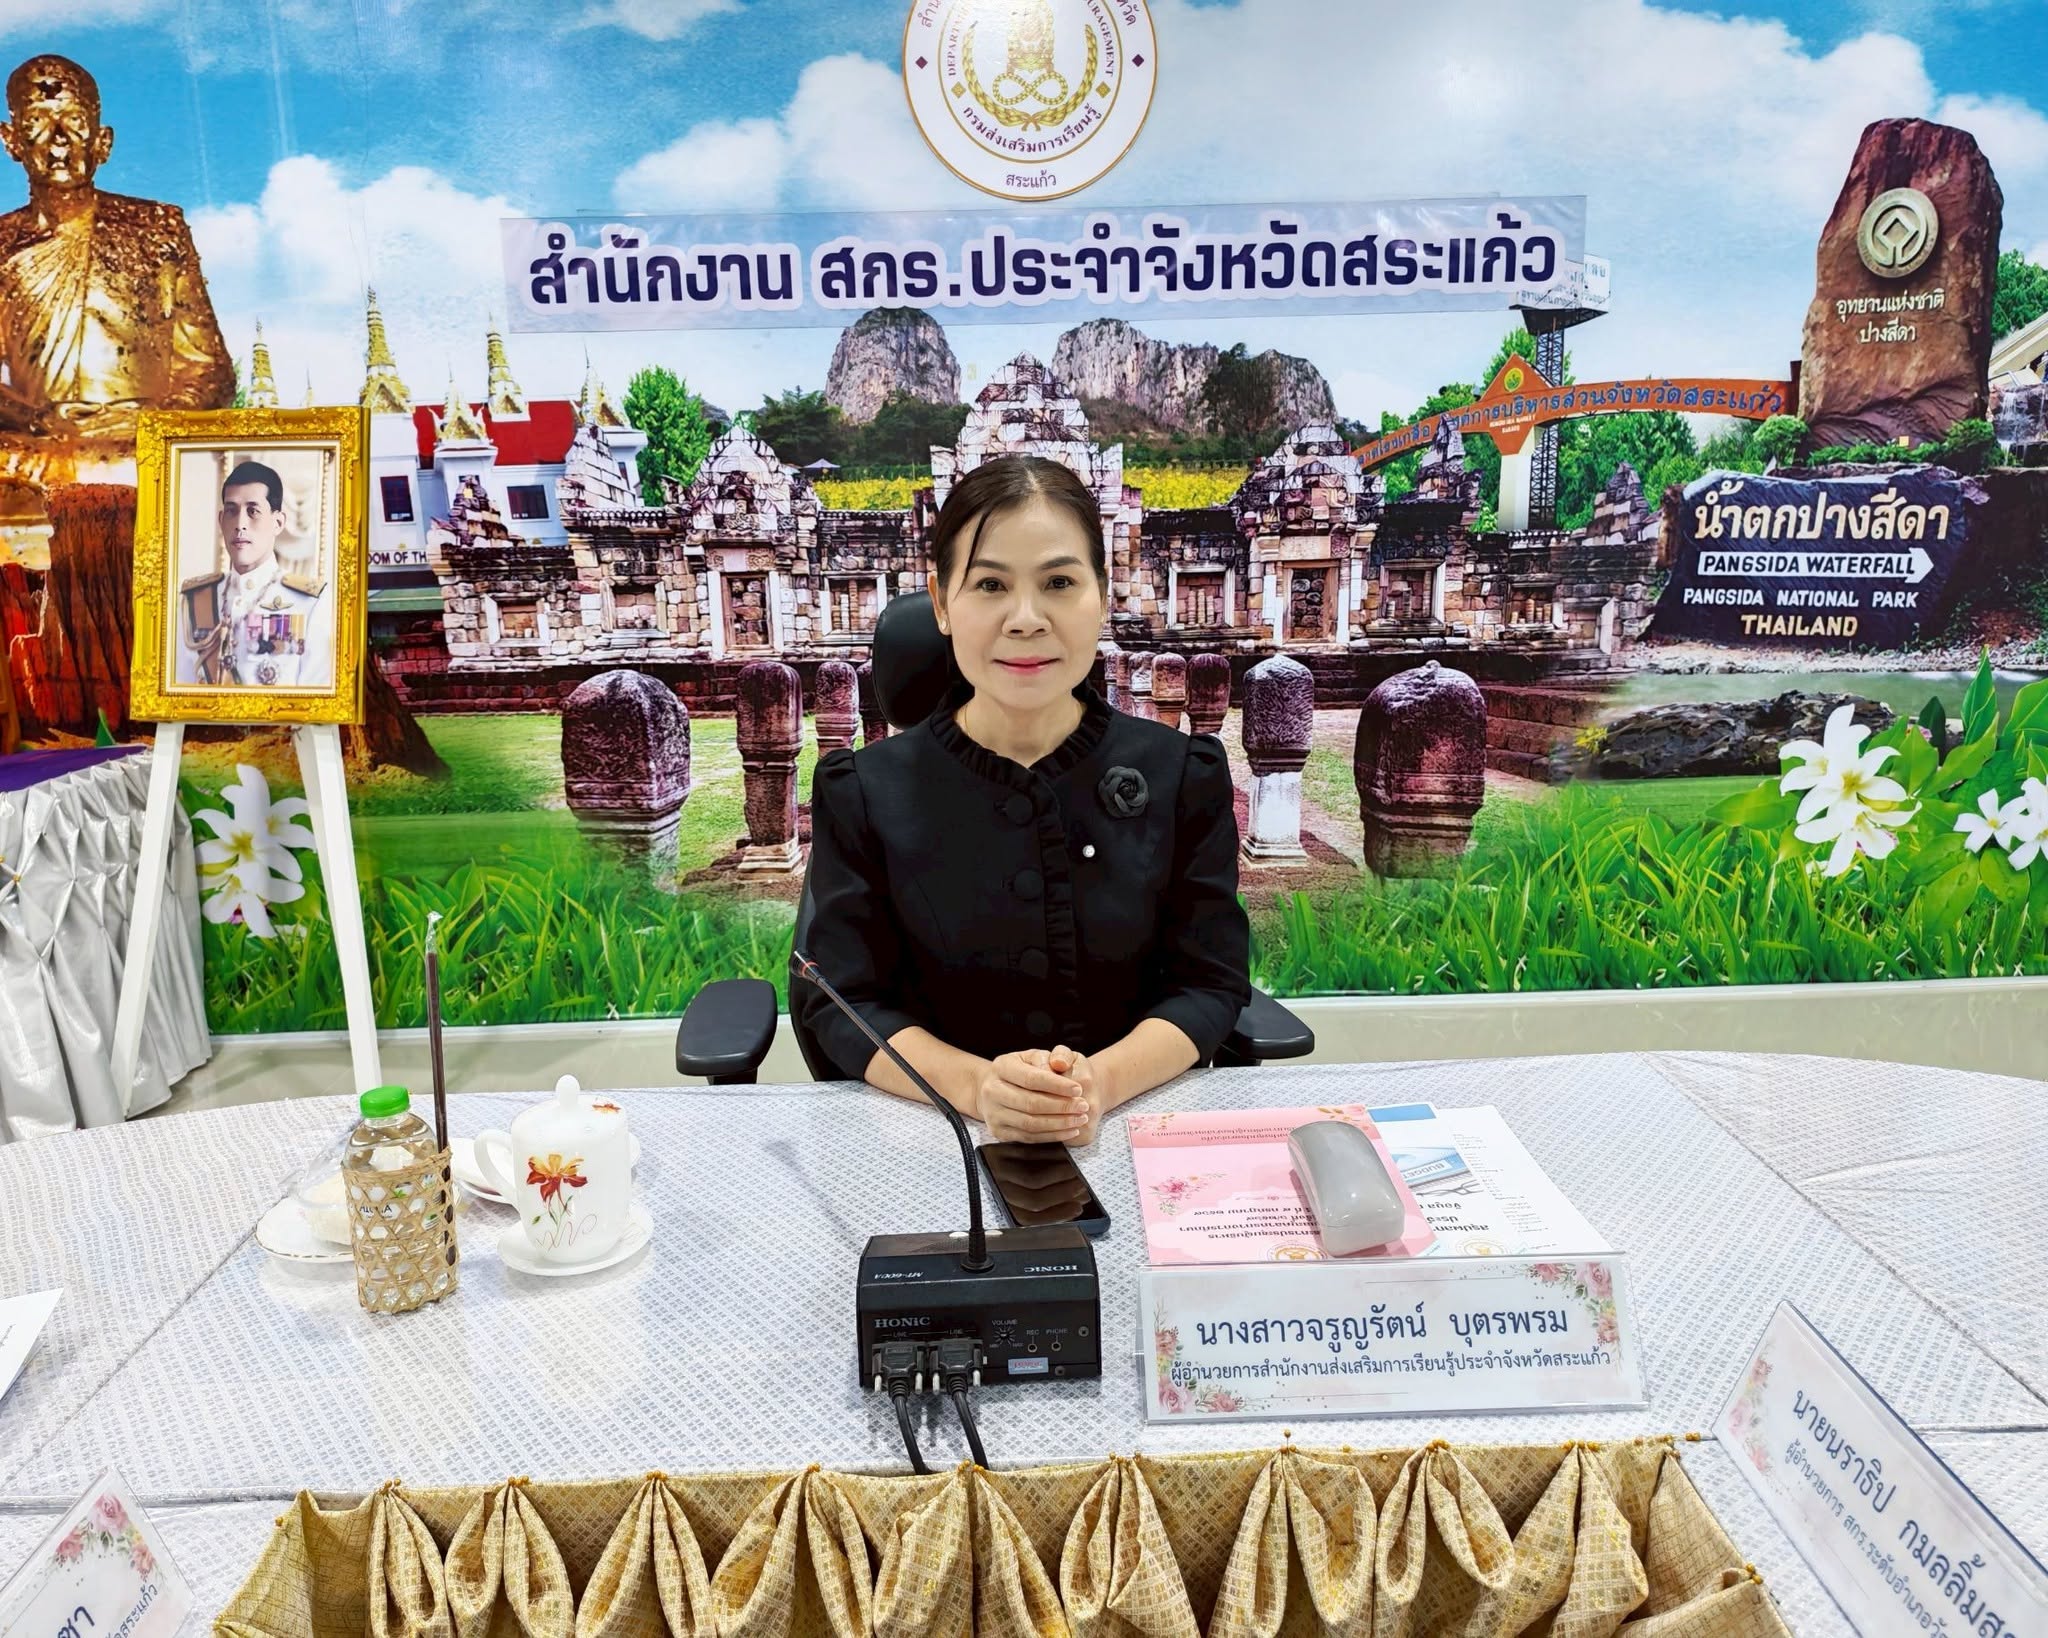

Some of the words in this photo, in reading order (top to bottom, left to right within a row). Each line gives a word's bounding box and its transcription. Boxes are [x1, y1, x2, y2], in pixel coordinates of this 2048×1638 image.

[1086, 0, 1115, 78] URAGEMENT
[963, 103, 1102, 153] กรมส่งเสริมการเรียนรู้
[1005, 169, 1057, 189] สระแก้ว
[529, 232, 793, 304] สำนักงาน
[820, 212, 1556, 300] สกร.ประจำจังหวัดสระแก้ว
[1836, 288, 1945, 321] อุทยานแห่งชาติ
[1859, 318, 1916, 343] ปางสีดา
[1452, 380, 1781, 429] งค์การบริหารส่วนจังหวัดสระแก้ว
[1694, 480, 1950, 540] น้ำตกปางสีดา
[393, 551, 408, 564] OF
[1703, 554, 1800, 574] PANGSIDA
[1806, 555, 1915, 575] WATERFALL
[1683, 588, 1764, 606] PANGSIDA
[1776, 589, 1859, 608] NATIONAL
[1872, 591, 1919, 609] PARK
[1740, 614, 1858, 637] THAILAND
[1402, 1163, 1445, 1178] BUDGET
[991, 1318, 1018, 1327] VOLUME
[1196, 1302, 1427, 1353] นางสาวจรูญรัตน์
[1449, 1303, 1568, 1348] บุตรพรม
[1170, 1347, 1611, 1386] ผู้อำนวยการสำนักงานส่งเสริมการเรียนรู้ประจำจังหวัดสระแก้ว
[1792, 1390, 1897, 1513] นายนราธิป
[1898, 1518, 2017, 1638] กมลลิ้มส
